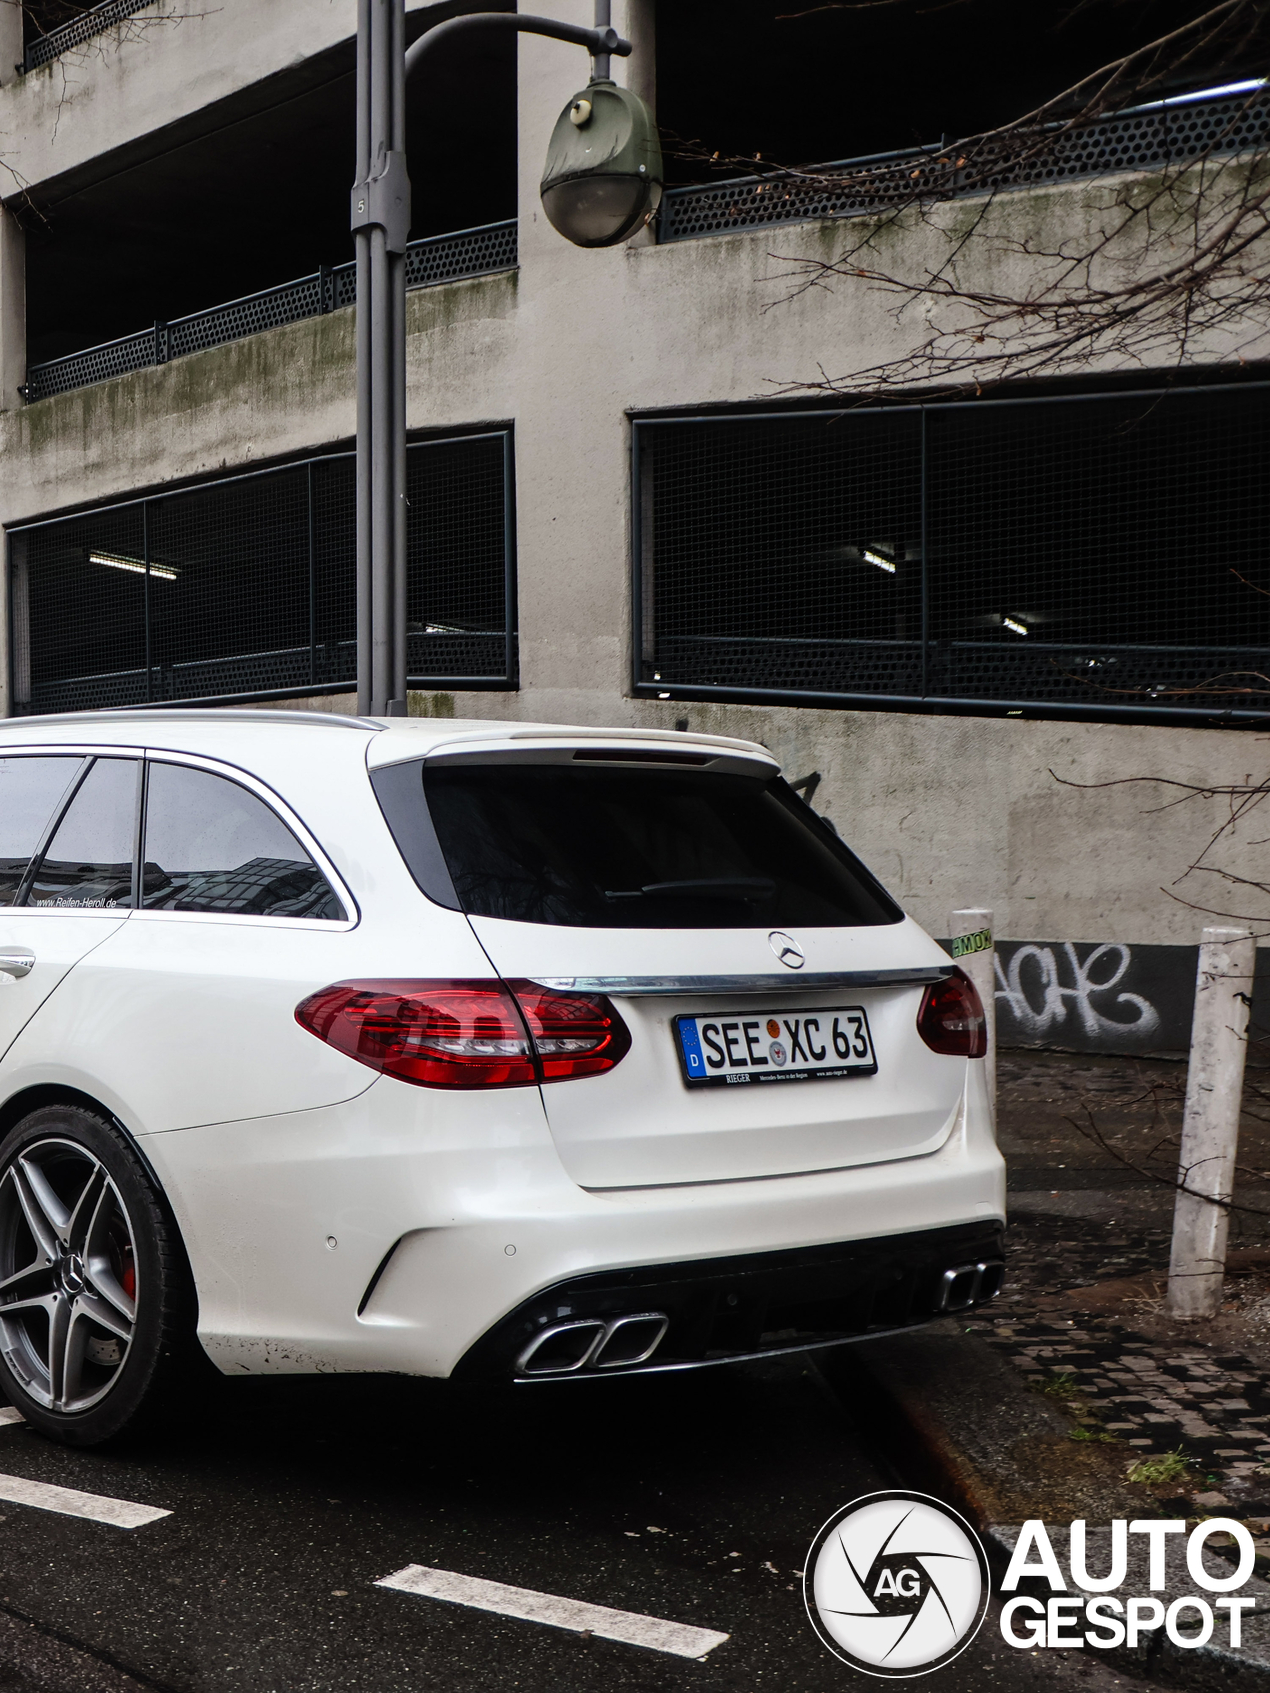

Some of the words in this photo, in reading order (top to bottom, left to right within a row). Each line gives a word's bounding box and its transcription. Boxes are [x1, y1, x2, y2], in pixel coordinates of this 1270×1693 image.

[36, 897, 117, 908] www.Reifen-Heroll.de
[690, 1053, 700, 1067] D
[702, 1021, 769, 1069] SEE
[782, 1018, 826, 1063] XC
[832, 1016, 869, 1060] 63
[726, 1073, 751, 1084] RIEGER
